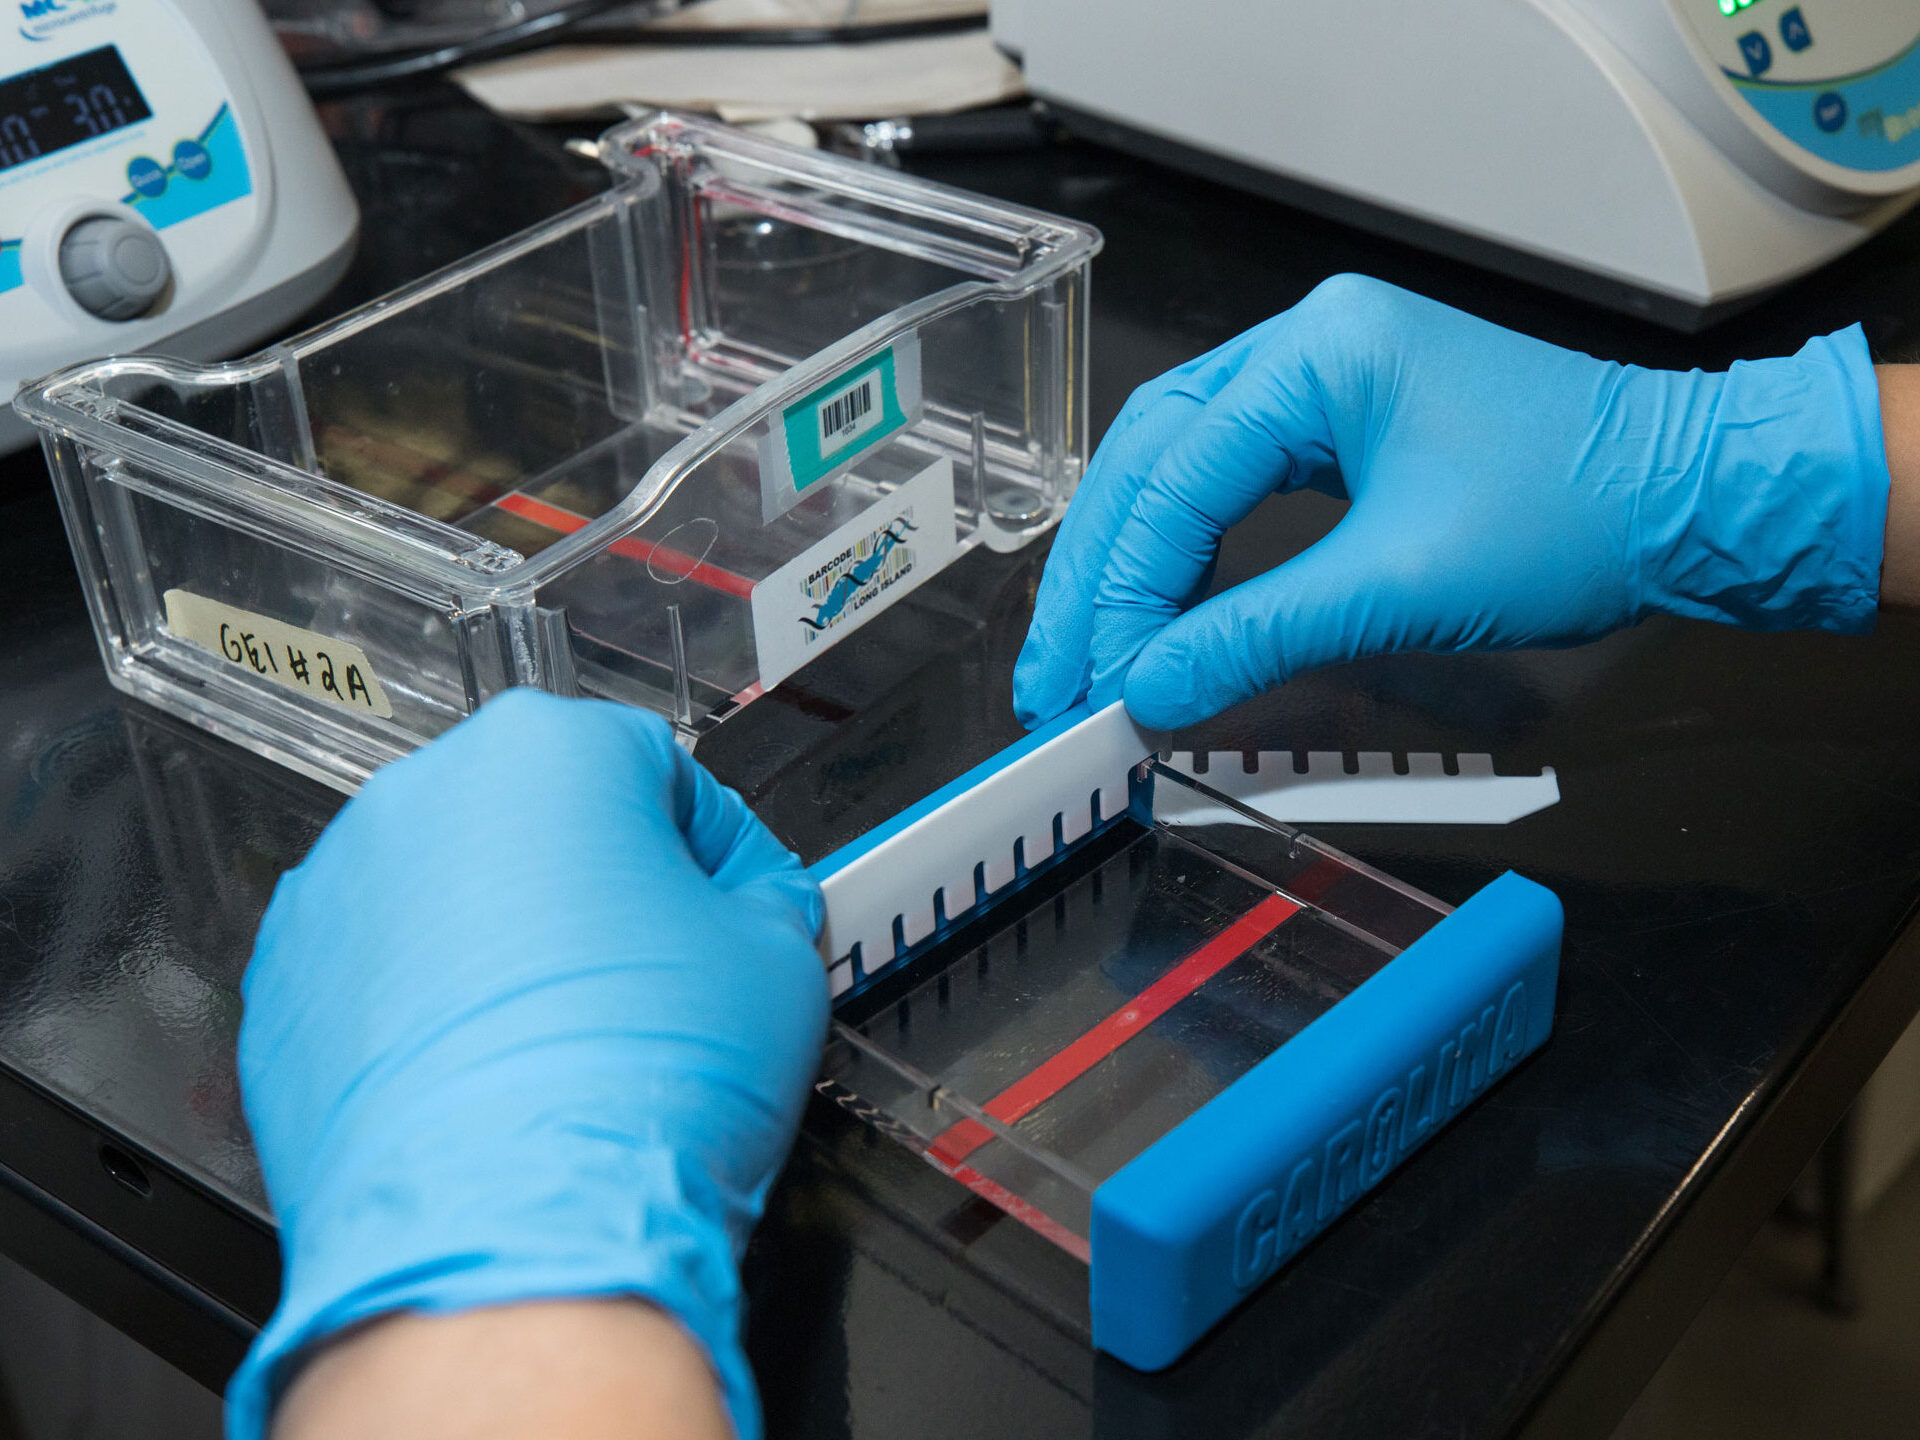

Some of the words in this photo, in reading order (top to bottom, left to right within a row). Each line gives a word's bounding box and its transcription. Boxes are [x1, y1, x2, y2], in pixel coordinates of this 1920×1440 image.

[808, 547, 853, 585] BARCODE
[854, 588, 879, 611] LONG
[880, 562, 913, 592] ISLAND
[1231, 980, 1529, 1289] CAROLINA
